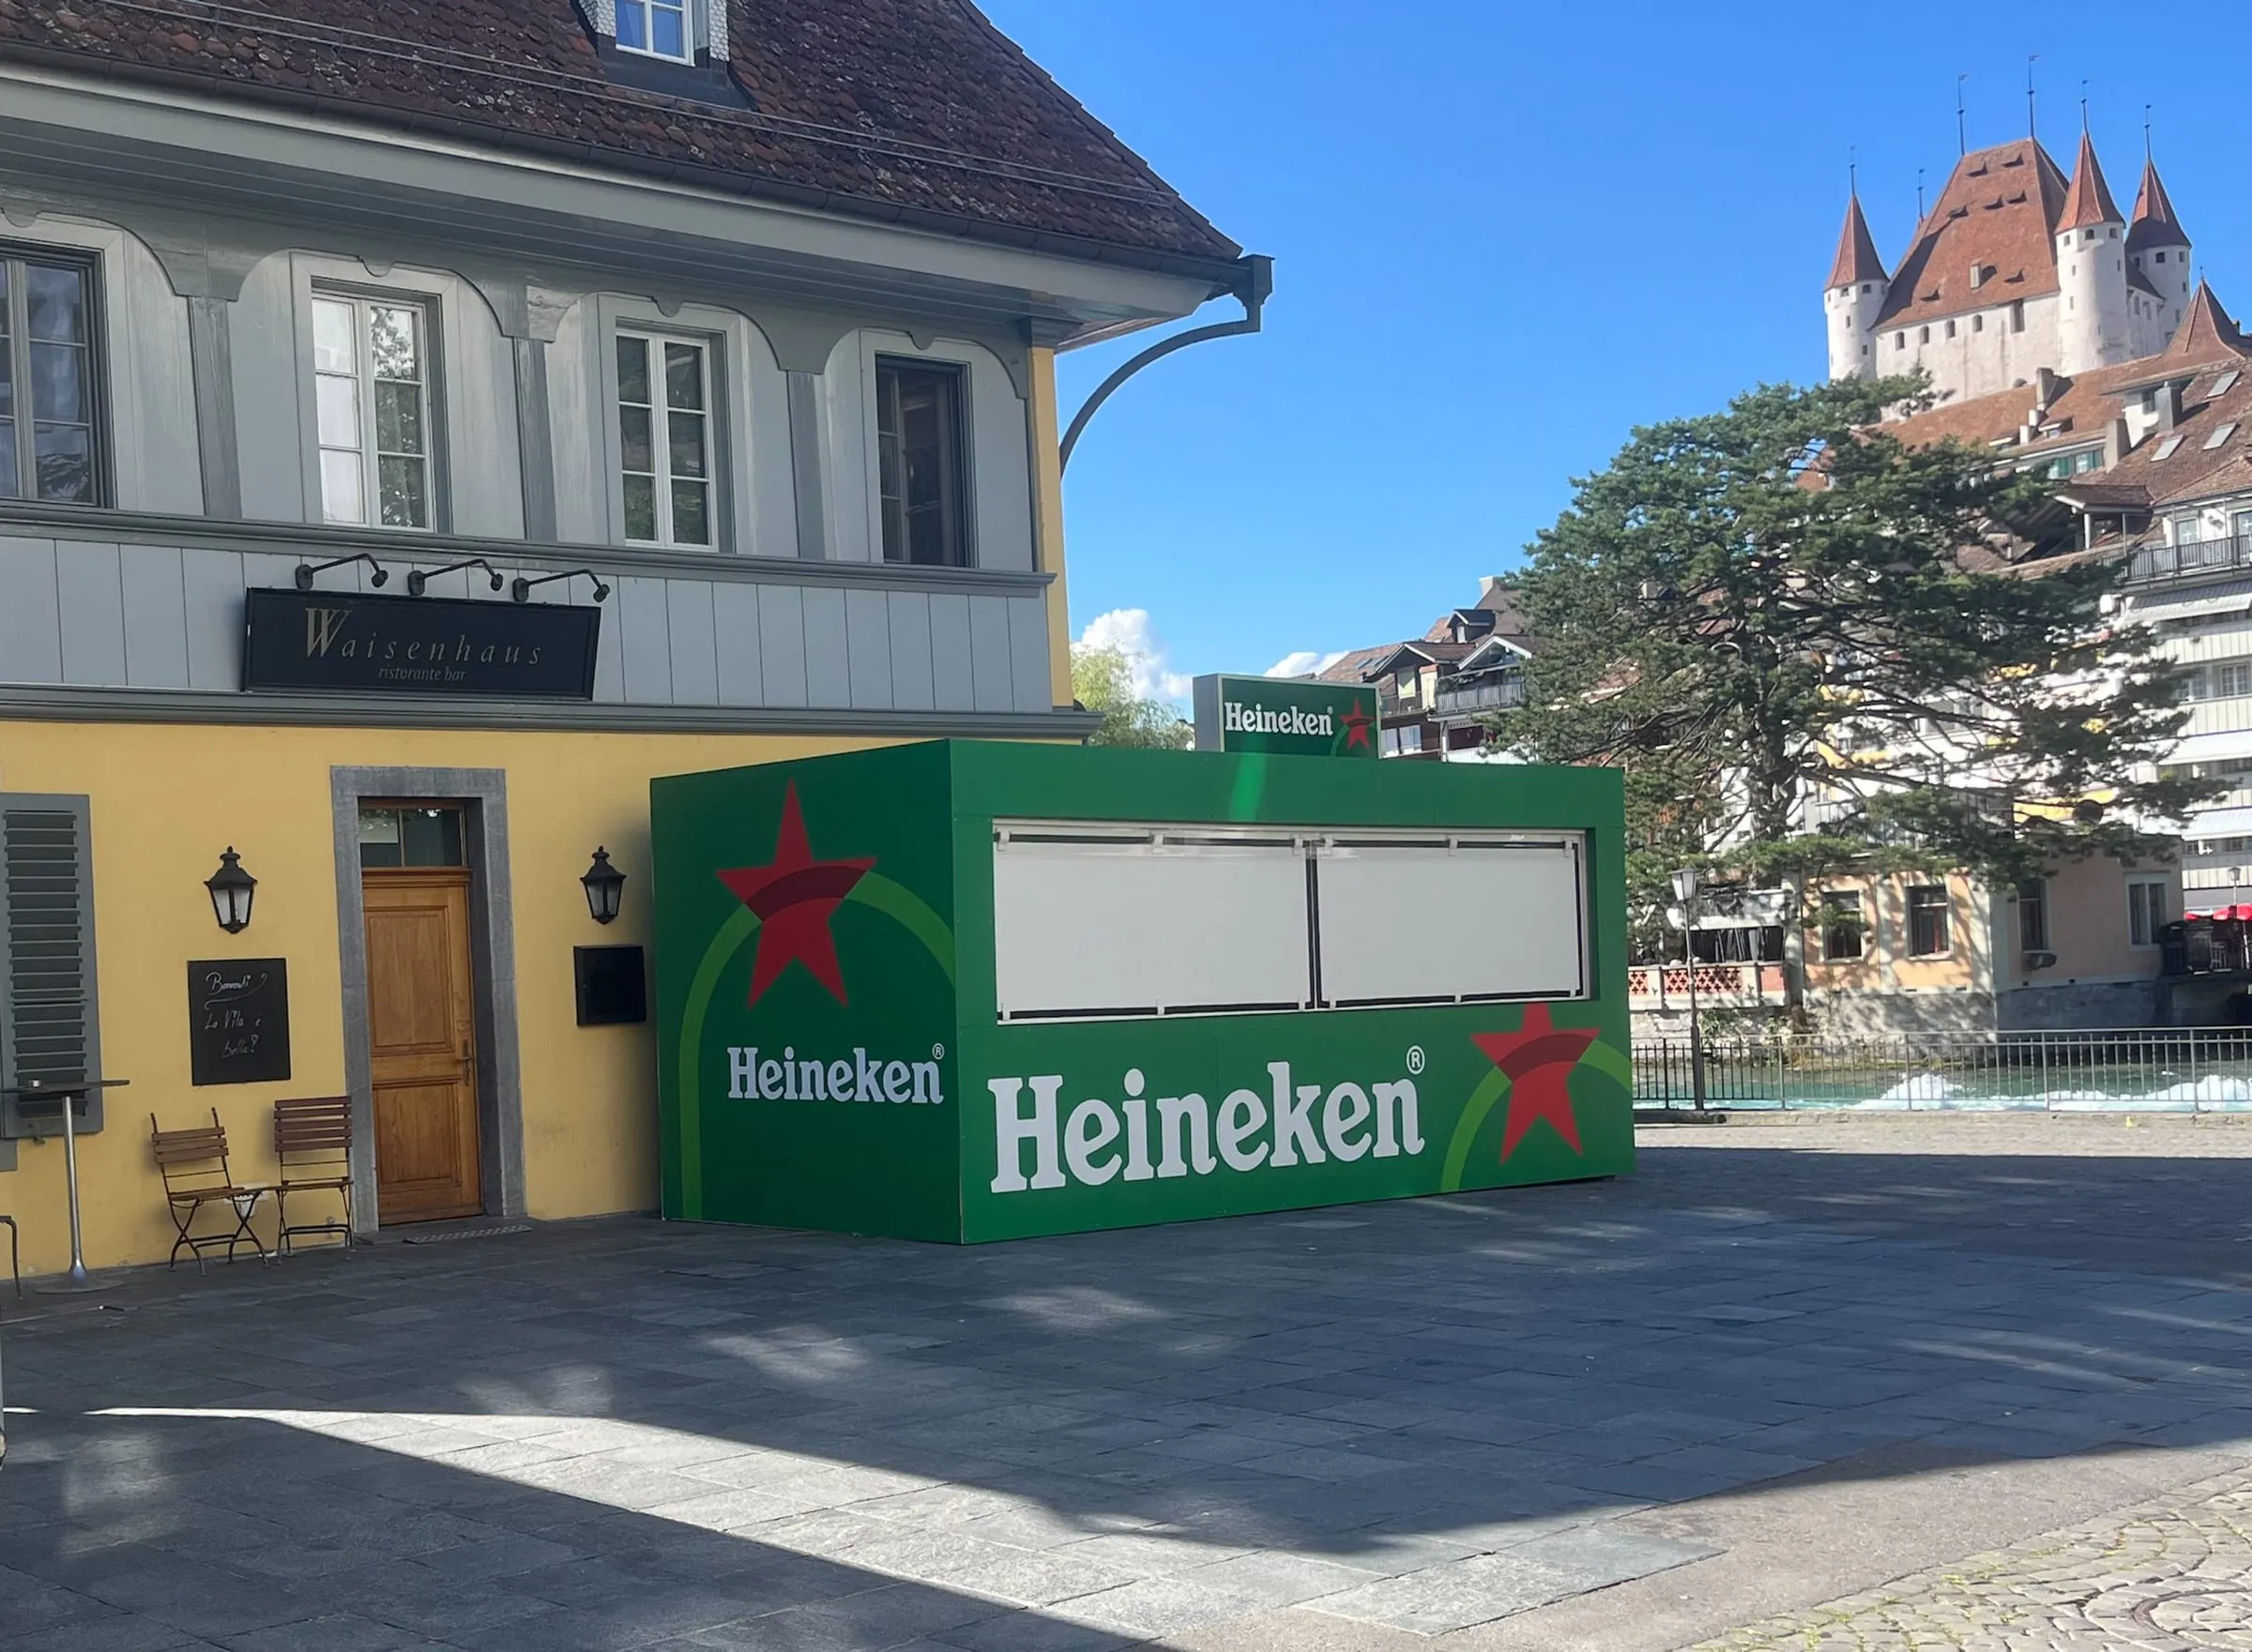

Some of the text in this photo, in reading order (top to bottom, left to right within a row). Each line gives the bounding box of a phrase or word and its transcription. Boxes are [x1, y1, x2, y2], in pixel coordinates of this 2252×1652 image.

[304, 607, 541, 665] Waisenhaus
[378, 666, 466, 682] ristorante bar
